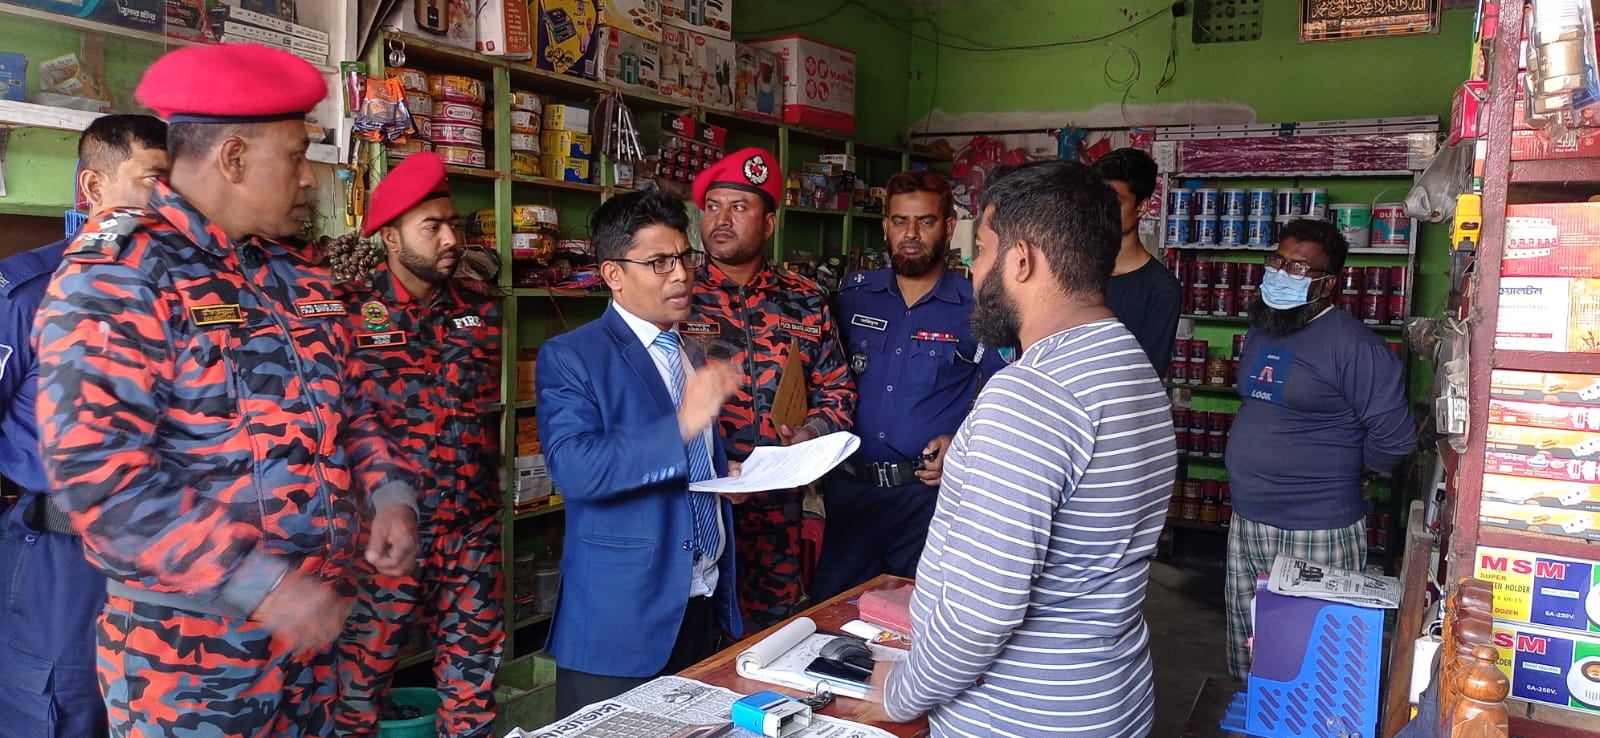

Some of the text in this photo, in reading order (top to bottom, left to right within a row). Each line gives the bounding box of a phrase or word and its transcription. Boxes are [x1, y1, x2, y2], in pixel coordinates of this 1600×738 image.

[1380, 210, 1405, 219] DUNL
[453, 315, 481, 328] FIRE
[1251, 390, 1273, 401] LOOK
[1480, 572, 1507, 582] SUPER
[1494, 582, 1531, 594] EN HOLDER
[1494, 607, 1519, 616] DOZEN
[1493, 631, 1547, 656] SM
[1496, 658, 1512, 667] LDER
